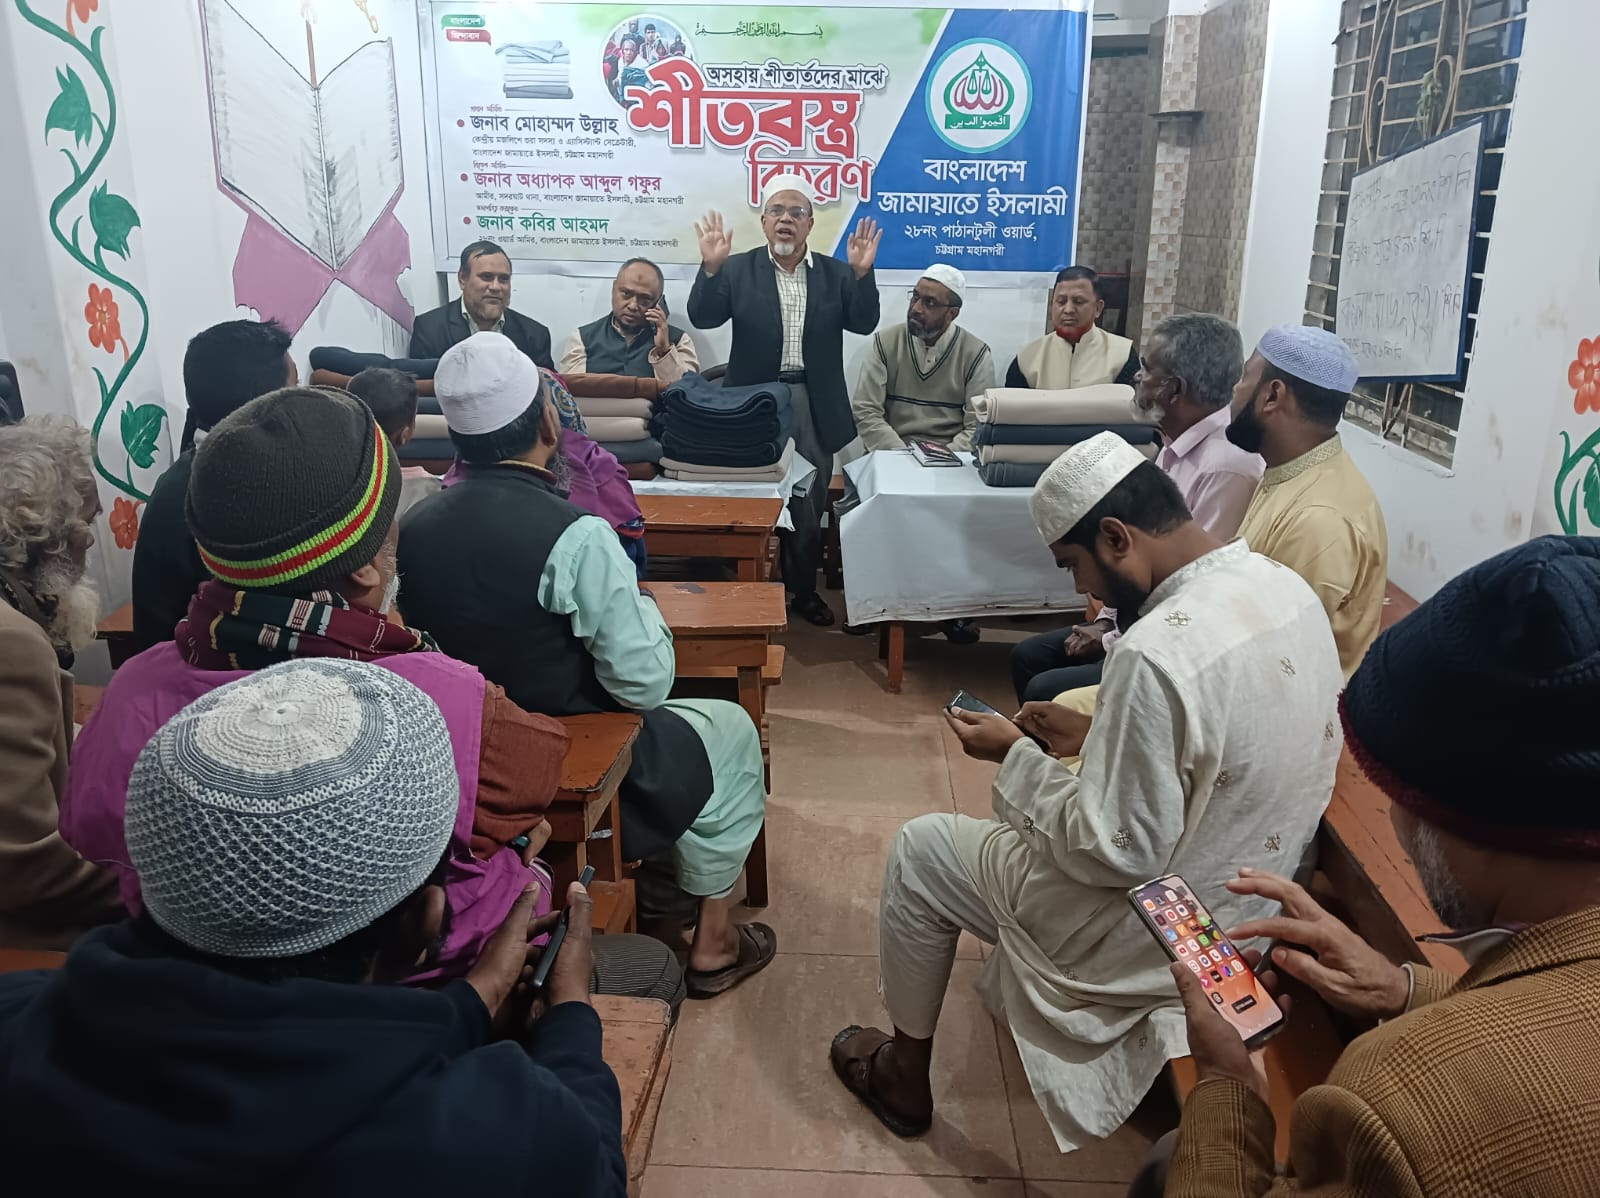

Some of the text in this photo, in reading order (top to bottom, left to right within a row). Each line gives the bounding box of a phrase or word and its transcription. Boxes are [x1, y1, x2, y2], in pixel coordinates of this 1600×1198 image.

[706, 62, 885, 86] অসহায় শীতার্তদের মাঝে
[627, 58, 860, 159] শীতবস্ত্র
[469, 112, 619, 135] জনাব মোহাম্মদ উল্লাহ
[473, 170, 662, 195] জনাব অধ্যাপক আব্দুল গফুর
[923, 158, 1027, 184] বাংলাদেশ
[877, 185, 1068, 217] জামায়াতে ইসলামী
[476, 211, 610, 234] জনাব কবির আহমদ
[904, 220, 1038, 241] ২৮নং পাঠানটুলী ওয়ার্ড,
[934, 243, 1006, 257] চট্টগ্রাম মহানগরী
